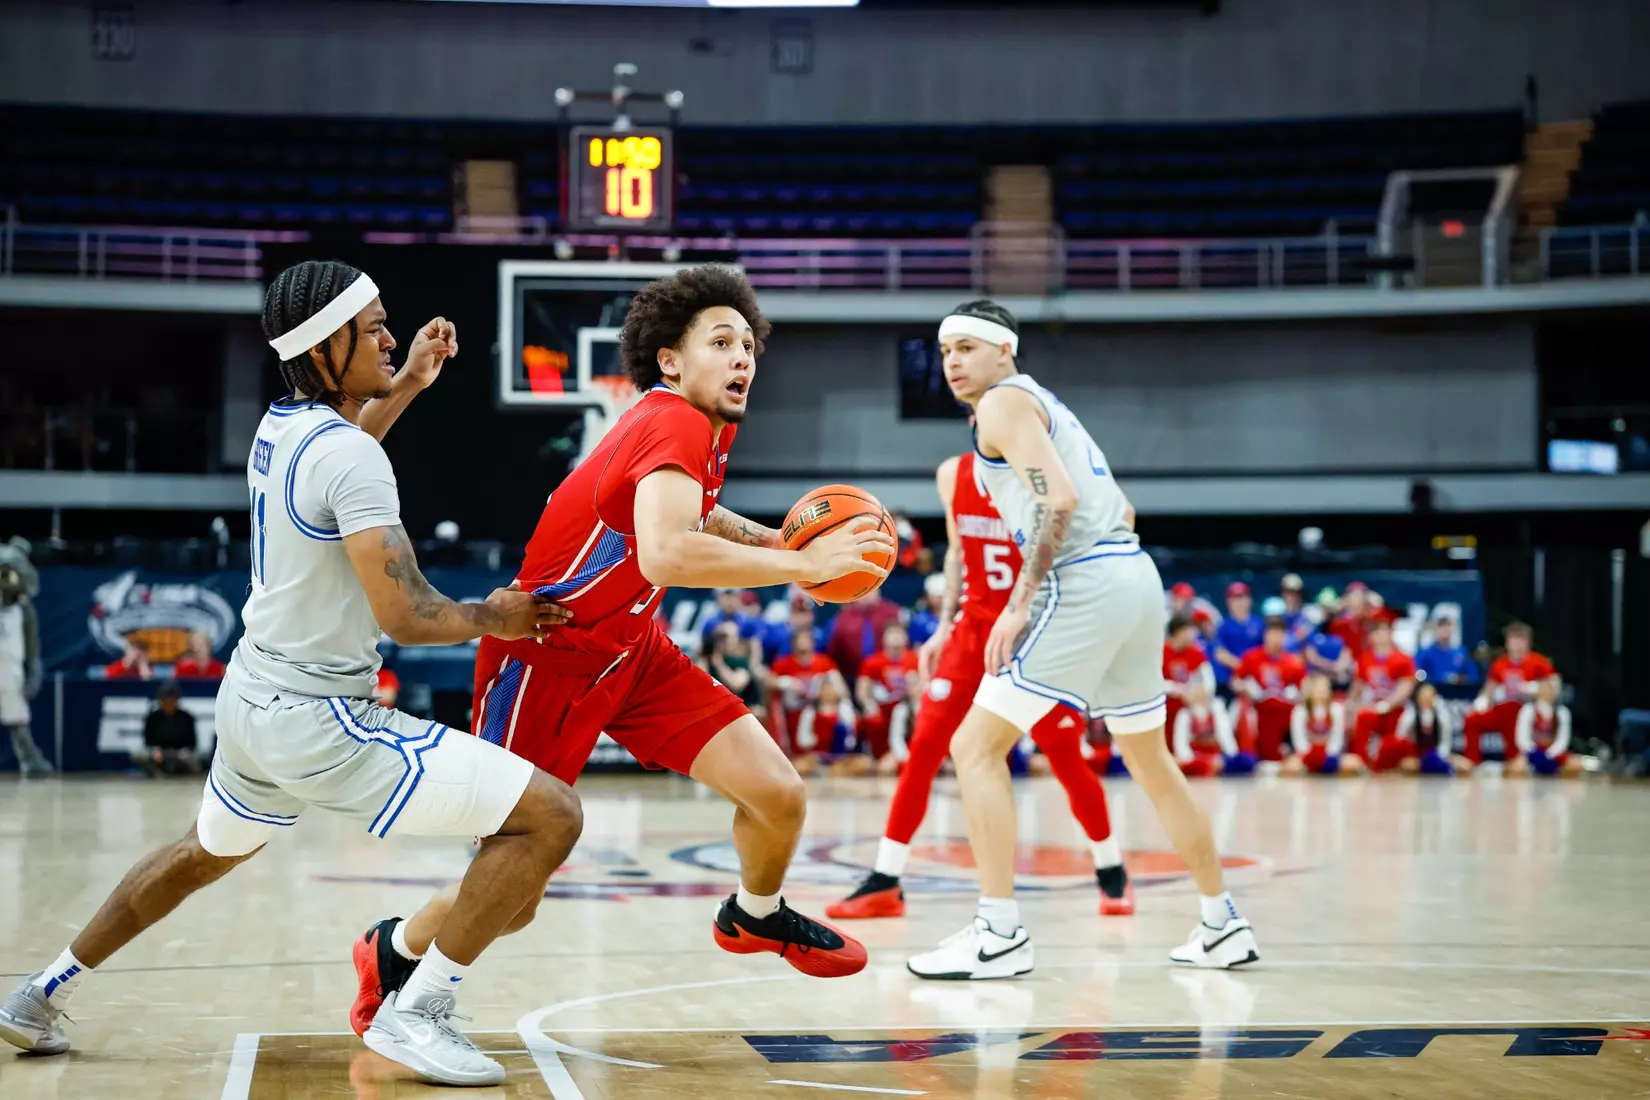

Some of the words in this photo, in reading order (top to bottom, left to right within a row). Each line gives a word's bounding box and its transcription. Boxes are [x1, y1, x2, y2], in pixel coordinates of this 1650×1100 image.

[606, 167, 652, 218] 10
[251, 484, 266, 586] 11
[783, 500, 831, 543] ELITE
[983, 543, 1015, 591] 5
